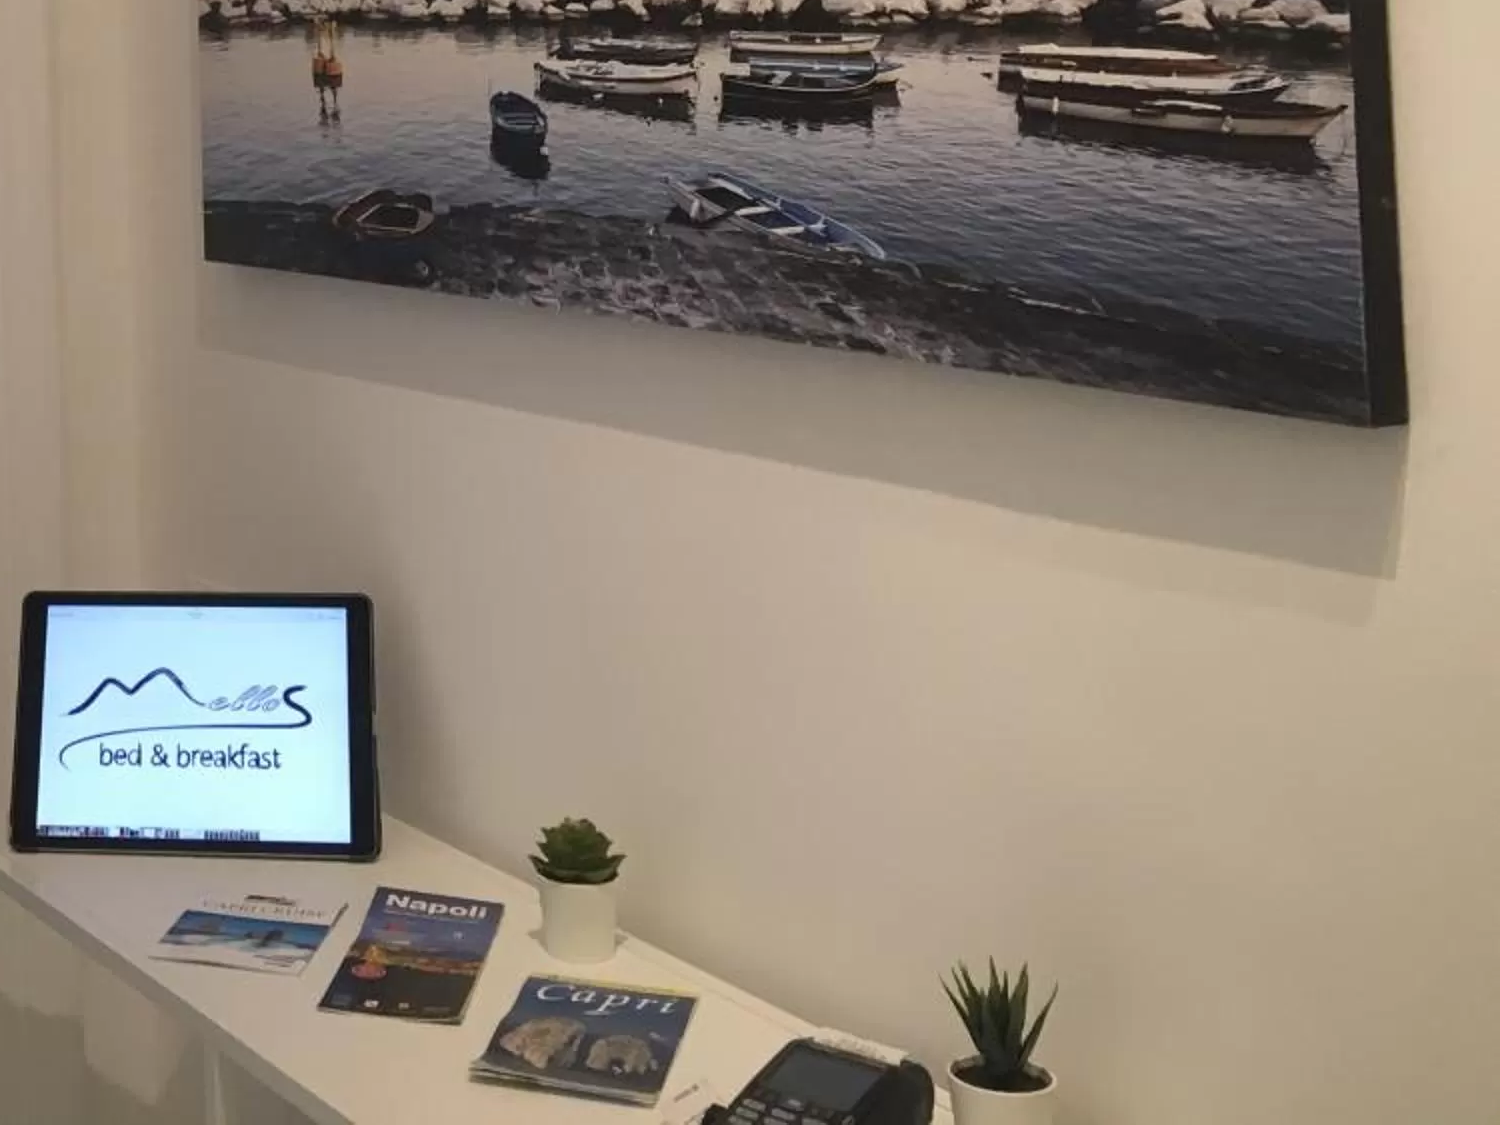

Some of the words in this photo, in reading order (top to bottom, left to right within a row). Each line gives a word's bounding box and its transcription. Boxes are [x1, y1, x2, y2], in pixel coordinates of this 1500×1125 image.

[98, 742, 142, 768] bed
[151, 743, 170, 768] &
[176, 742, 283, 770] breakfast
[385, 893, 489, 920] Napoli
[536, 983, 681, 1016] Capri
